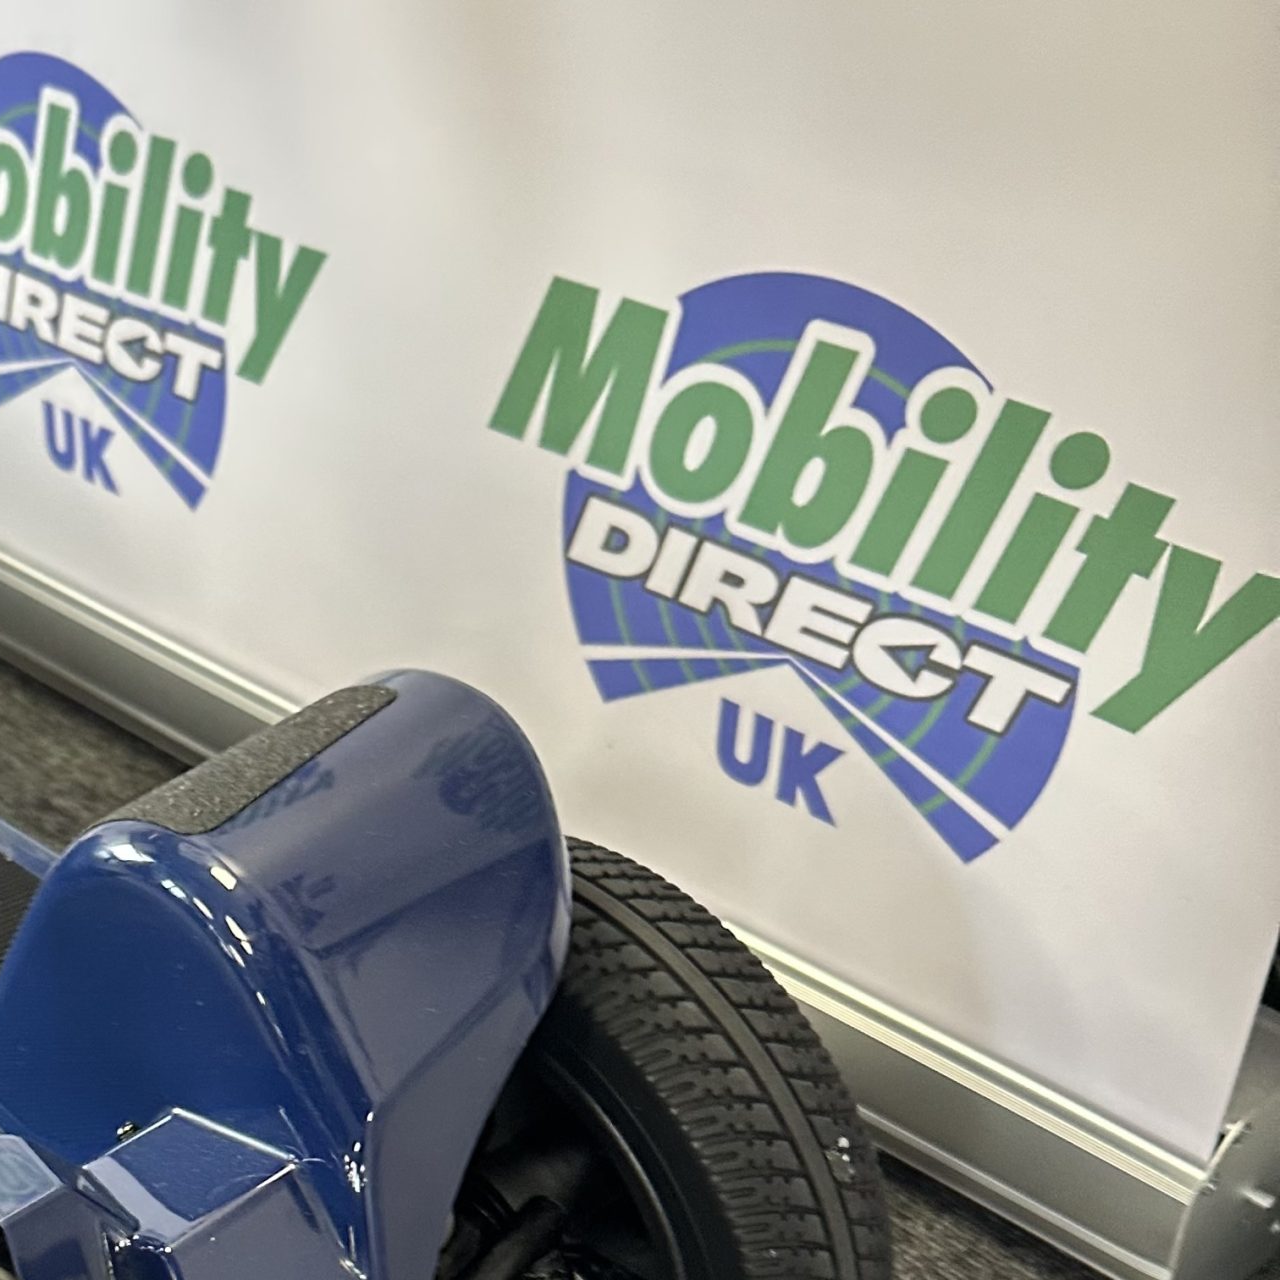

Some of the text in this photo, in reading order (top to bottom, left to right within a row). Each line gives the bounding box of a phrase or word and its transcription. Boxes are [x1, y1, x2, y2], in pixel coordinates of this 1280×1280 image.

[42, 400, 119, 496] UK
[487, 275, 1280, 734] Mobility
[566, 496, 1073, 734] DIRECT
[717, 697, 847, 827] UK
